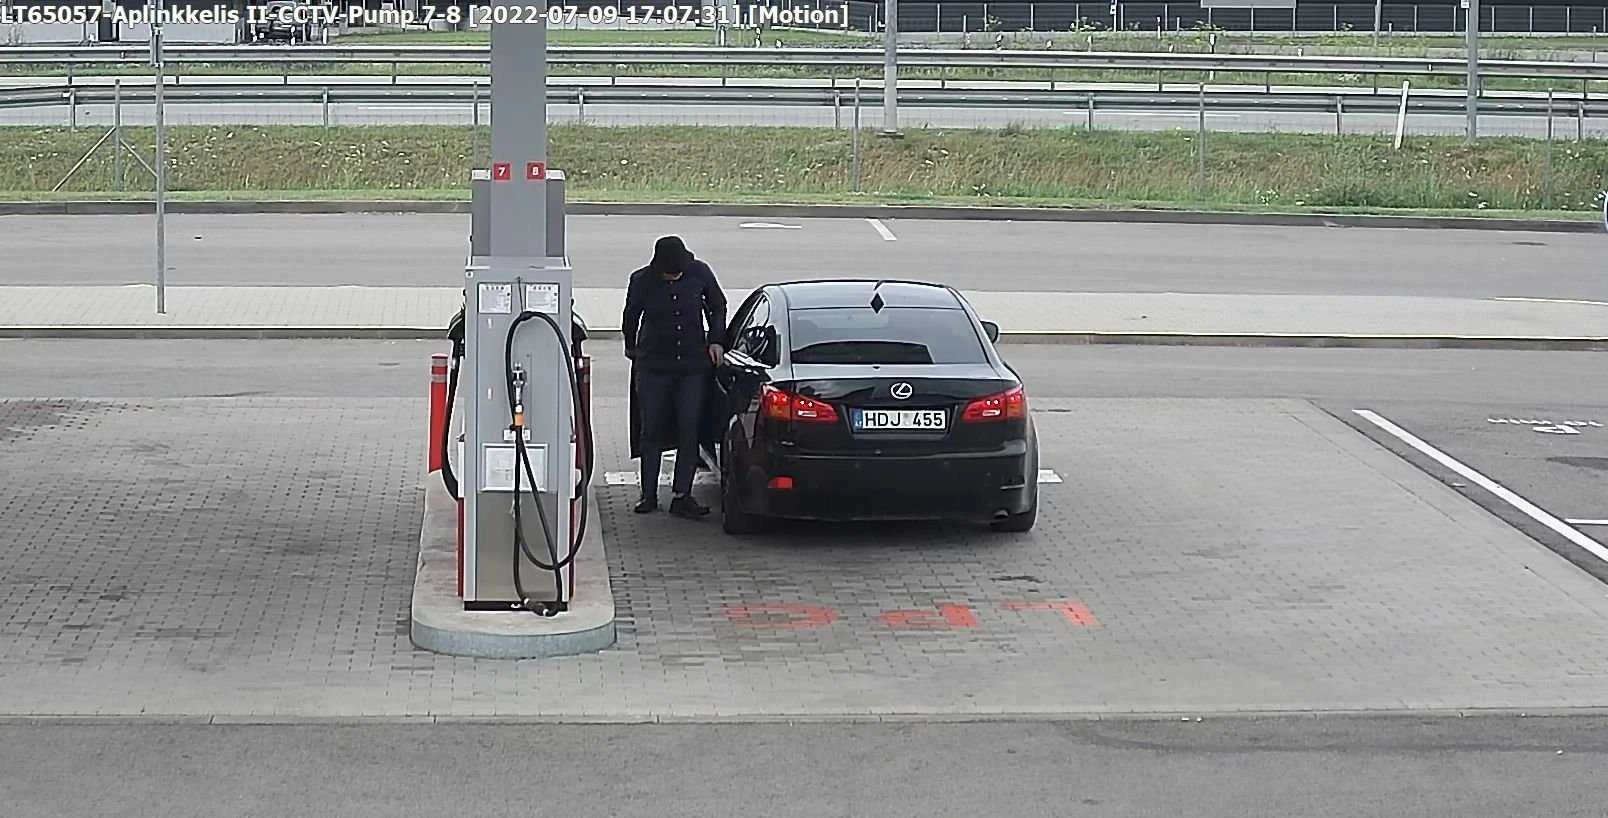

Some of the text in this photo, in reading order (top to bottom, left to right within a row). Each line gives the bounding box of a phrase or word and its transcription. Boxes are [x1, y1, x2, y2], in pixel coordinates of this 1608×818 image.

[498, 167, 505, 177] 7
[532, 166, 539, 176] 8
[865, 412, 943, 427] HDJ 455
